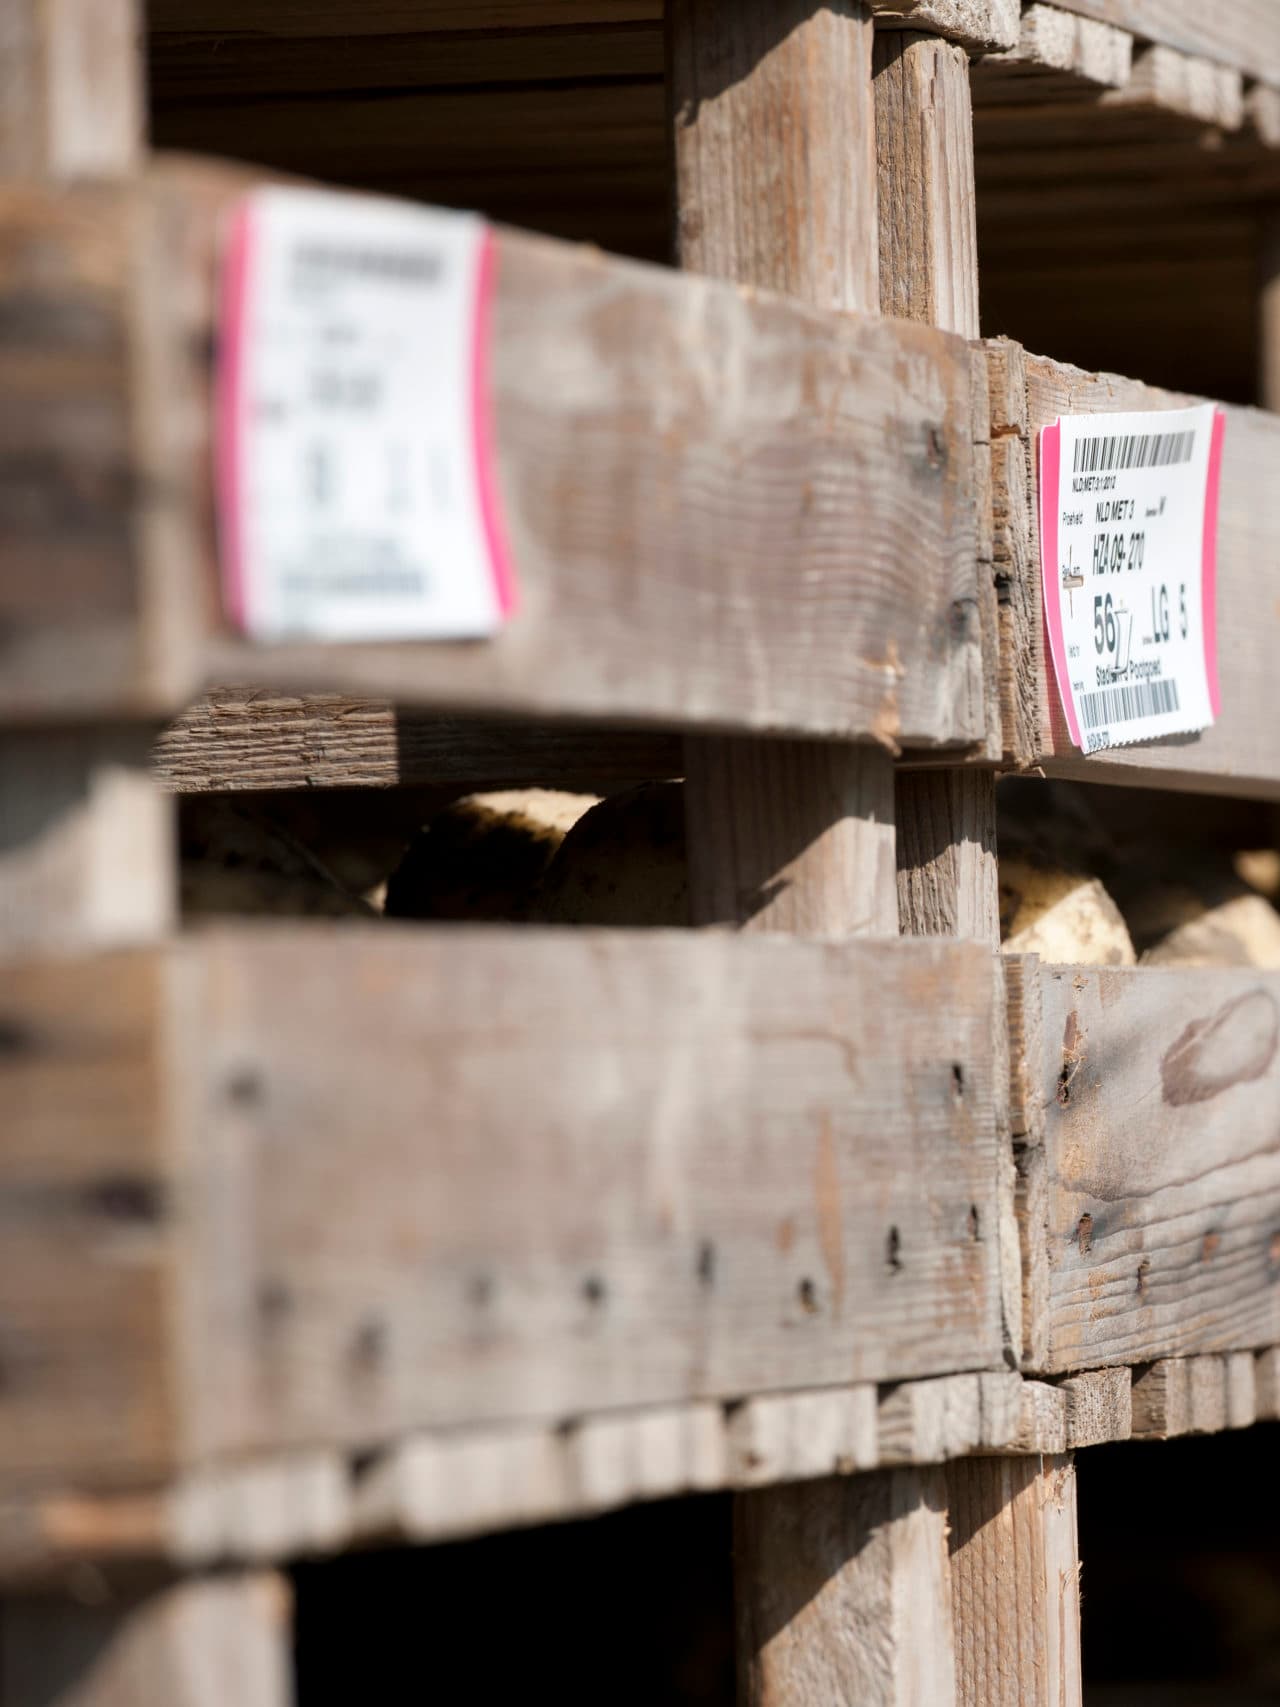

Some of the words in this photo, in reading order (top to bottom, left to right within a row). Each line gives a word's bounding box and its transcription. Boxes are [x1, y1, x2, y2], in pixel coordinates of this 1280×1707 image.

[1096, 501, 1110, 523] NLD
[1111, 499, 1129, 521] MET
[1093, 533, 1109, 577] HZA
[1094, 592, 1116, 655] 56
[1152, 584, 1169, 643] LG
